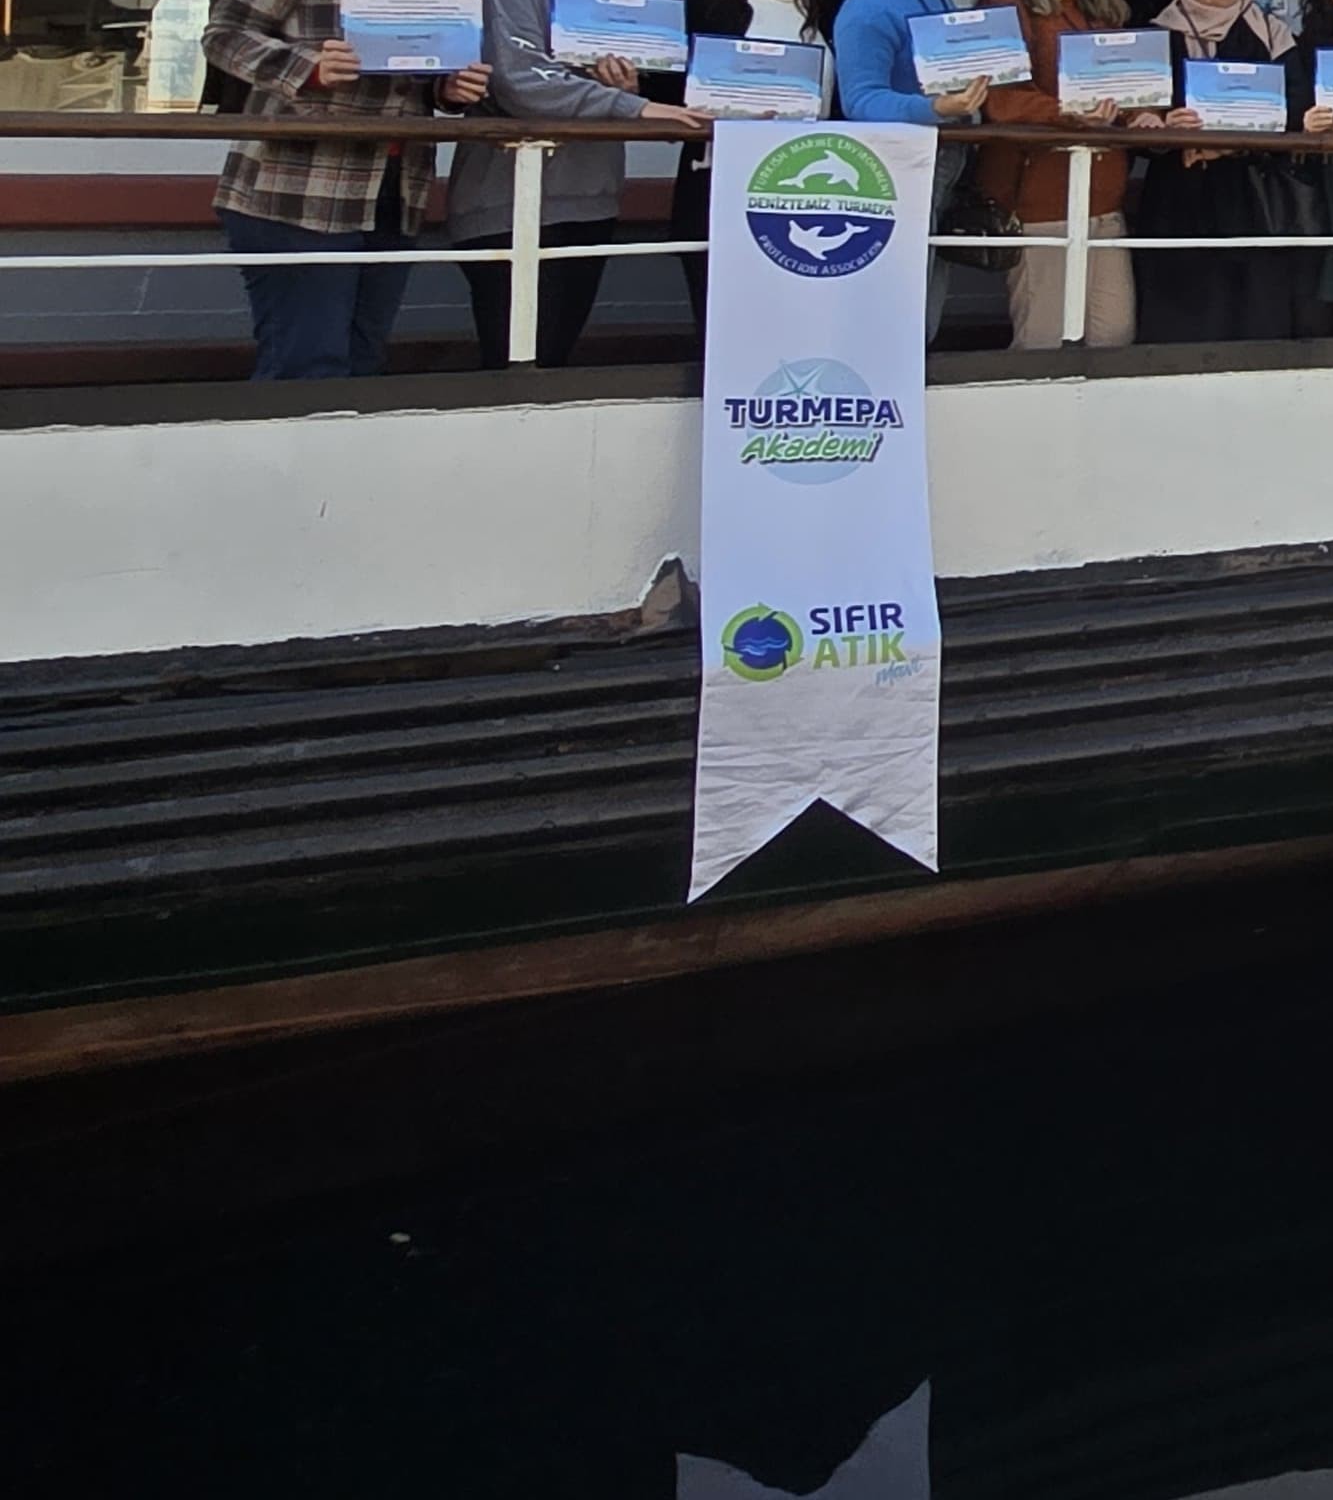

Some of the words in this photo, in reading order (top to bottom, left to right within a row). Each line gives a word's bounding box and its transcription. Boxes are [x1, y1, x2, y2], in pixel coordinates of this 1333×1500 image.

[753, 151, 789, 191] TURKISH
[790, 137, 832, 155] MARINE
[837, 138, 892, 198] ENVIRONMENT
[837, 200, 895, 217] TURMEPA
[758, 234, 818, 275] PROTECTION
[821, 240, 883, 275] ASSOCIATION
[723, 397, 903, 427] TURMEPA
[740, 430, 883, 463] Akademi
[809, 602, 905, 636] SIFIR
[812, 631, 908, 670] ATIK
